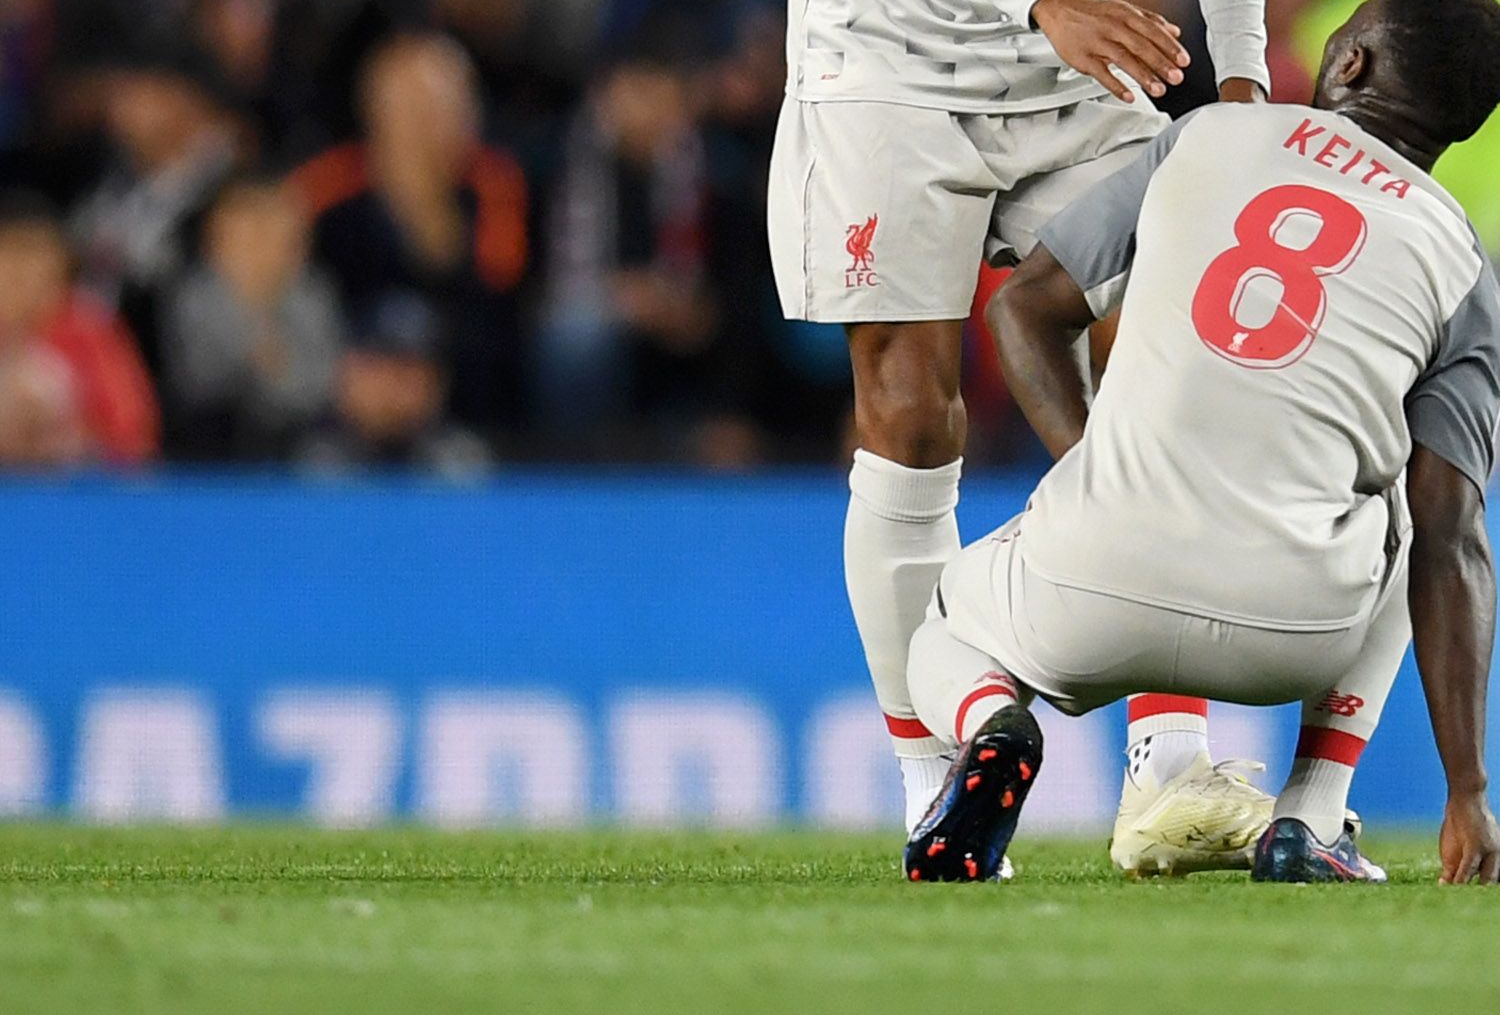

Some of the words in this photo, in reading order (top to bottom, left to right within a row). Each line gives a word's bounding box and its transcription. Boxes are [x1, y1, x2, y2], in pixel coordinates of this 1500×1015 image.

[1283, 118, 1411, 200] KEITA
[845, 272, 881, 288] LFC
[1192, 184, 1367, 370] 8
